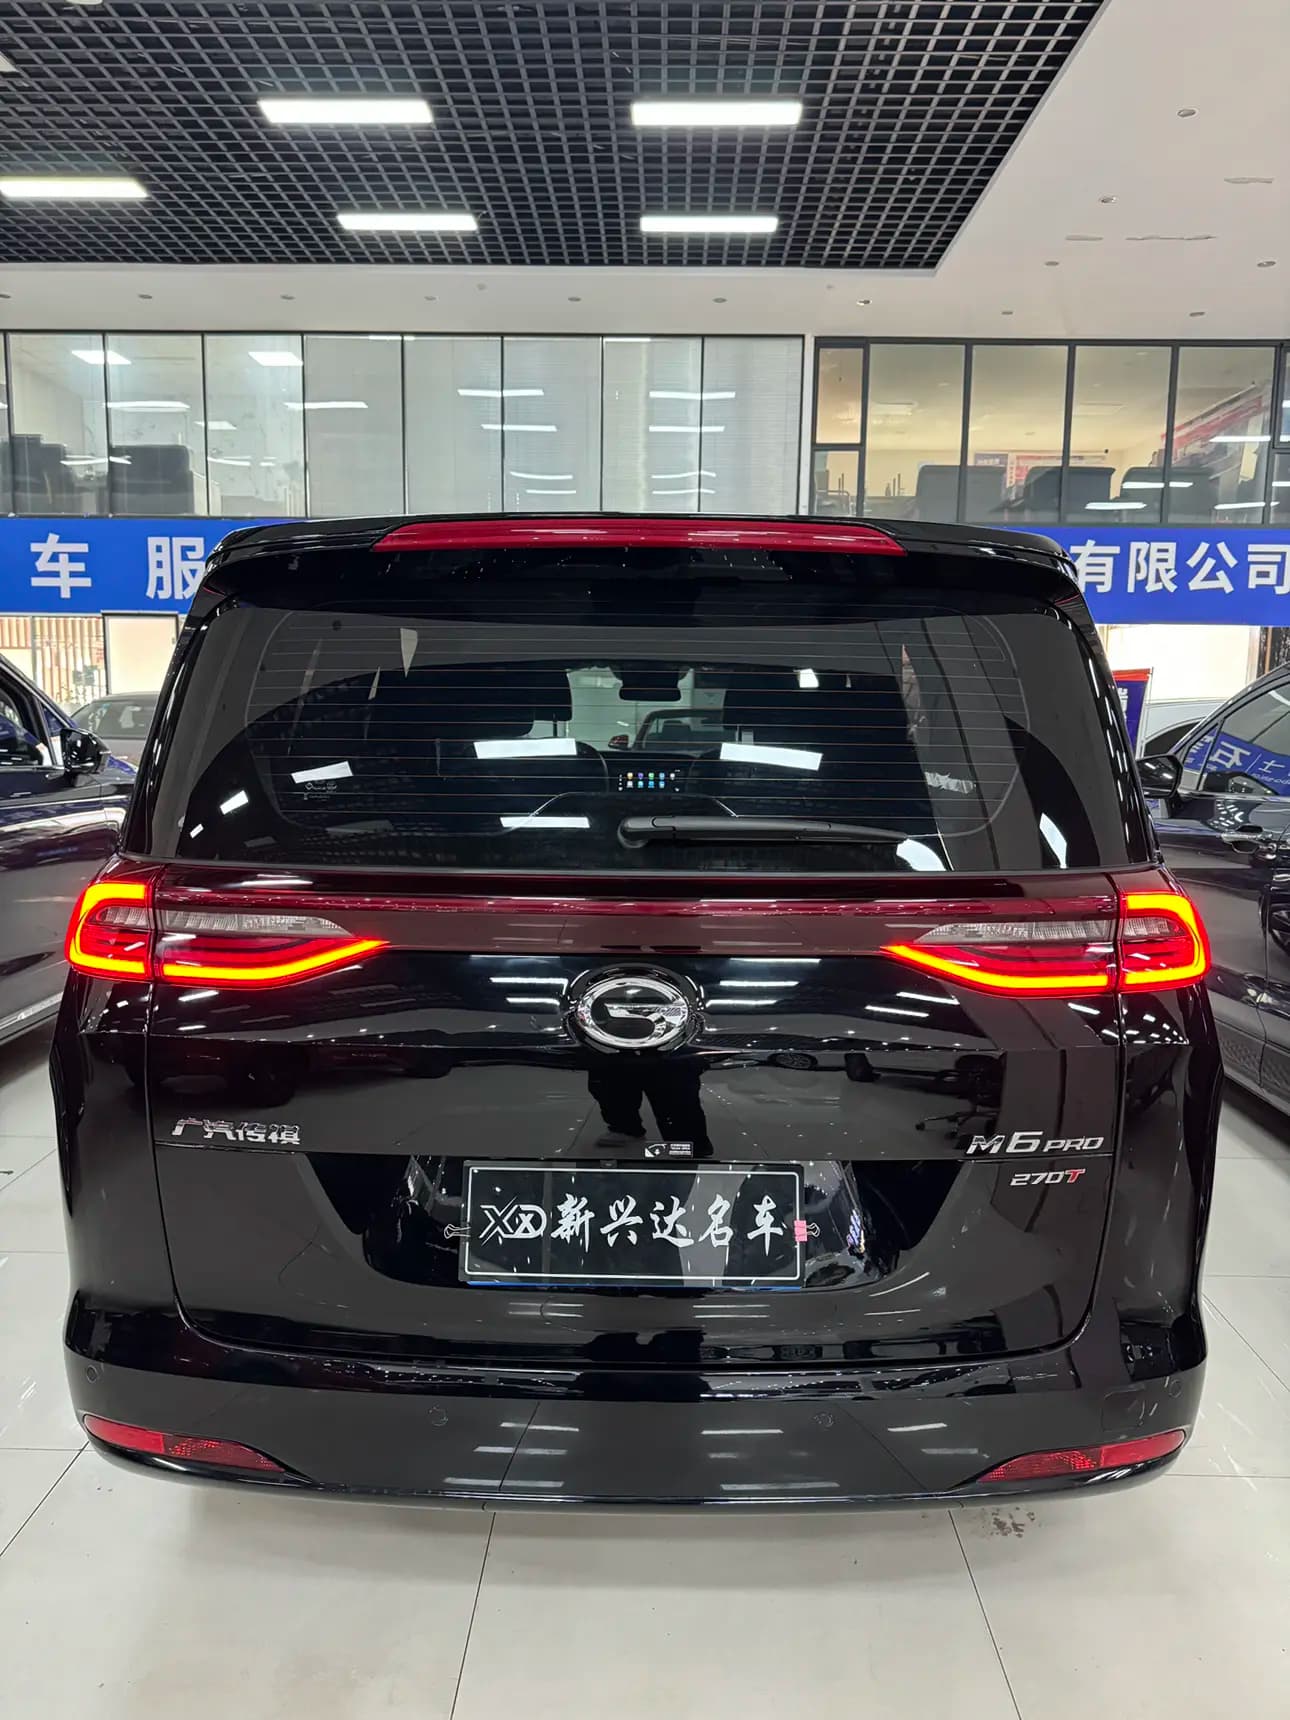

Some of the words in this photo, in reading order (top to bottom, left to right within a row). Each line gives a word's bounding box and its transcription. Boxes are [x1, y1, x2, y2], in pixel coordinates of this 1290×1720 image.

[1069, 539, 1290, 595] 有限公司
[966, 1131, 1043, 1154] M6
[1043, 1136, 1104, 1152] PRO
[1010, 1168, 1086, 1186] 270T
[551, 1193, 785, 1256] 新兴达名车
